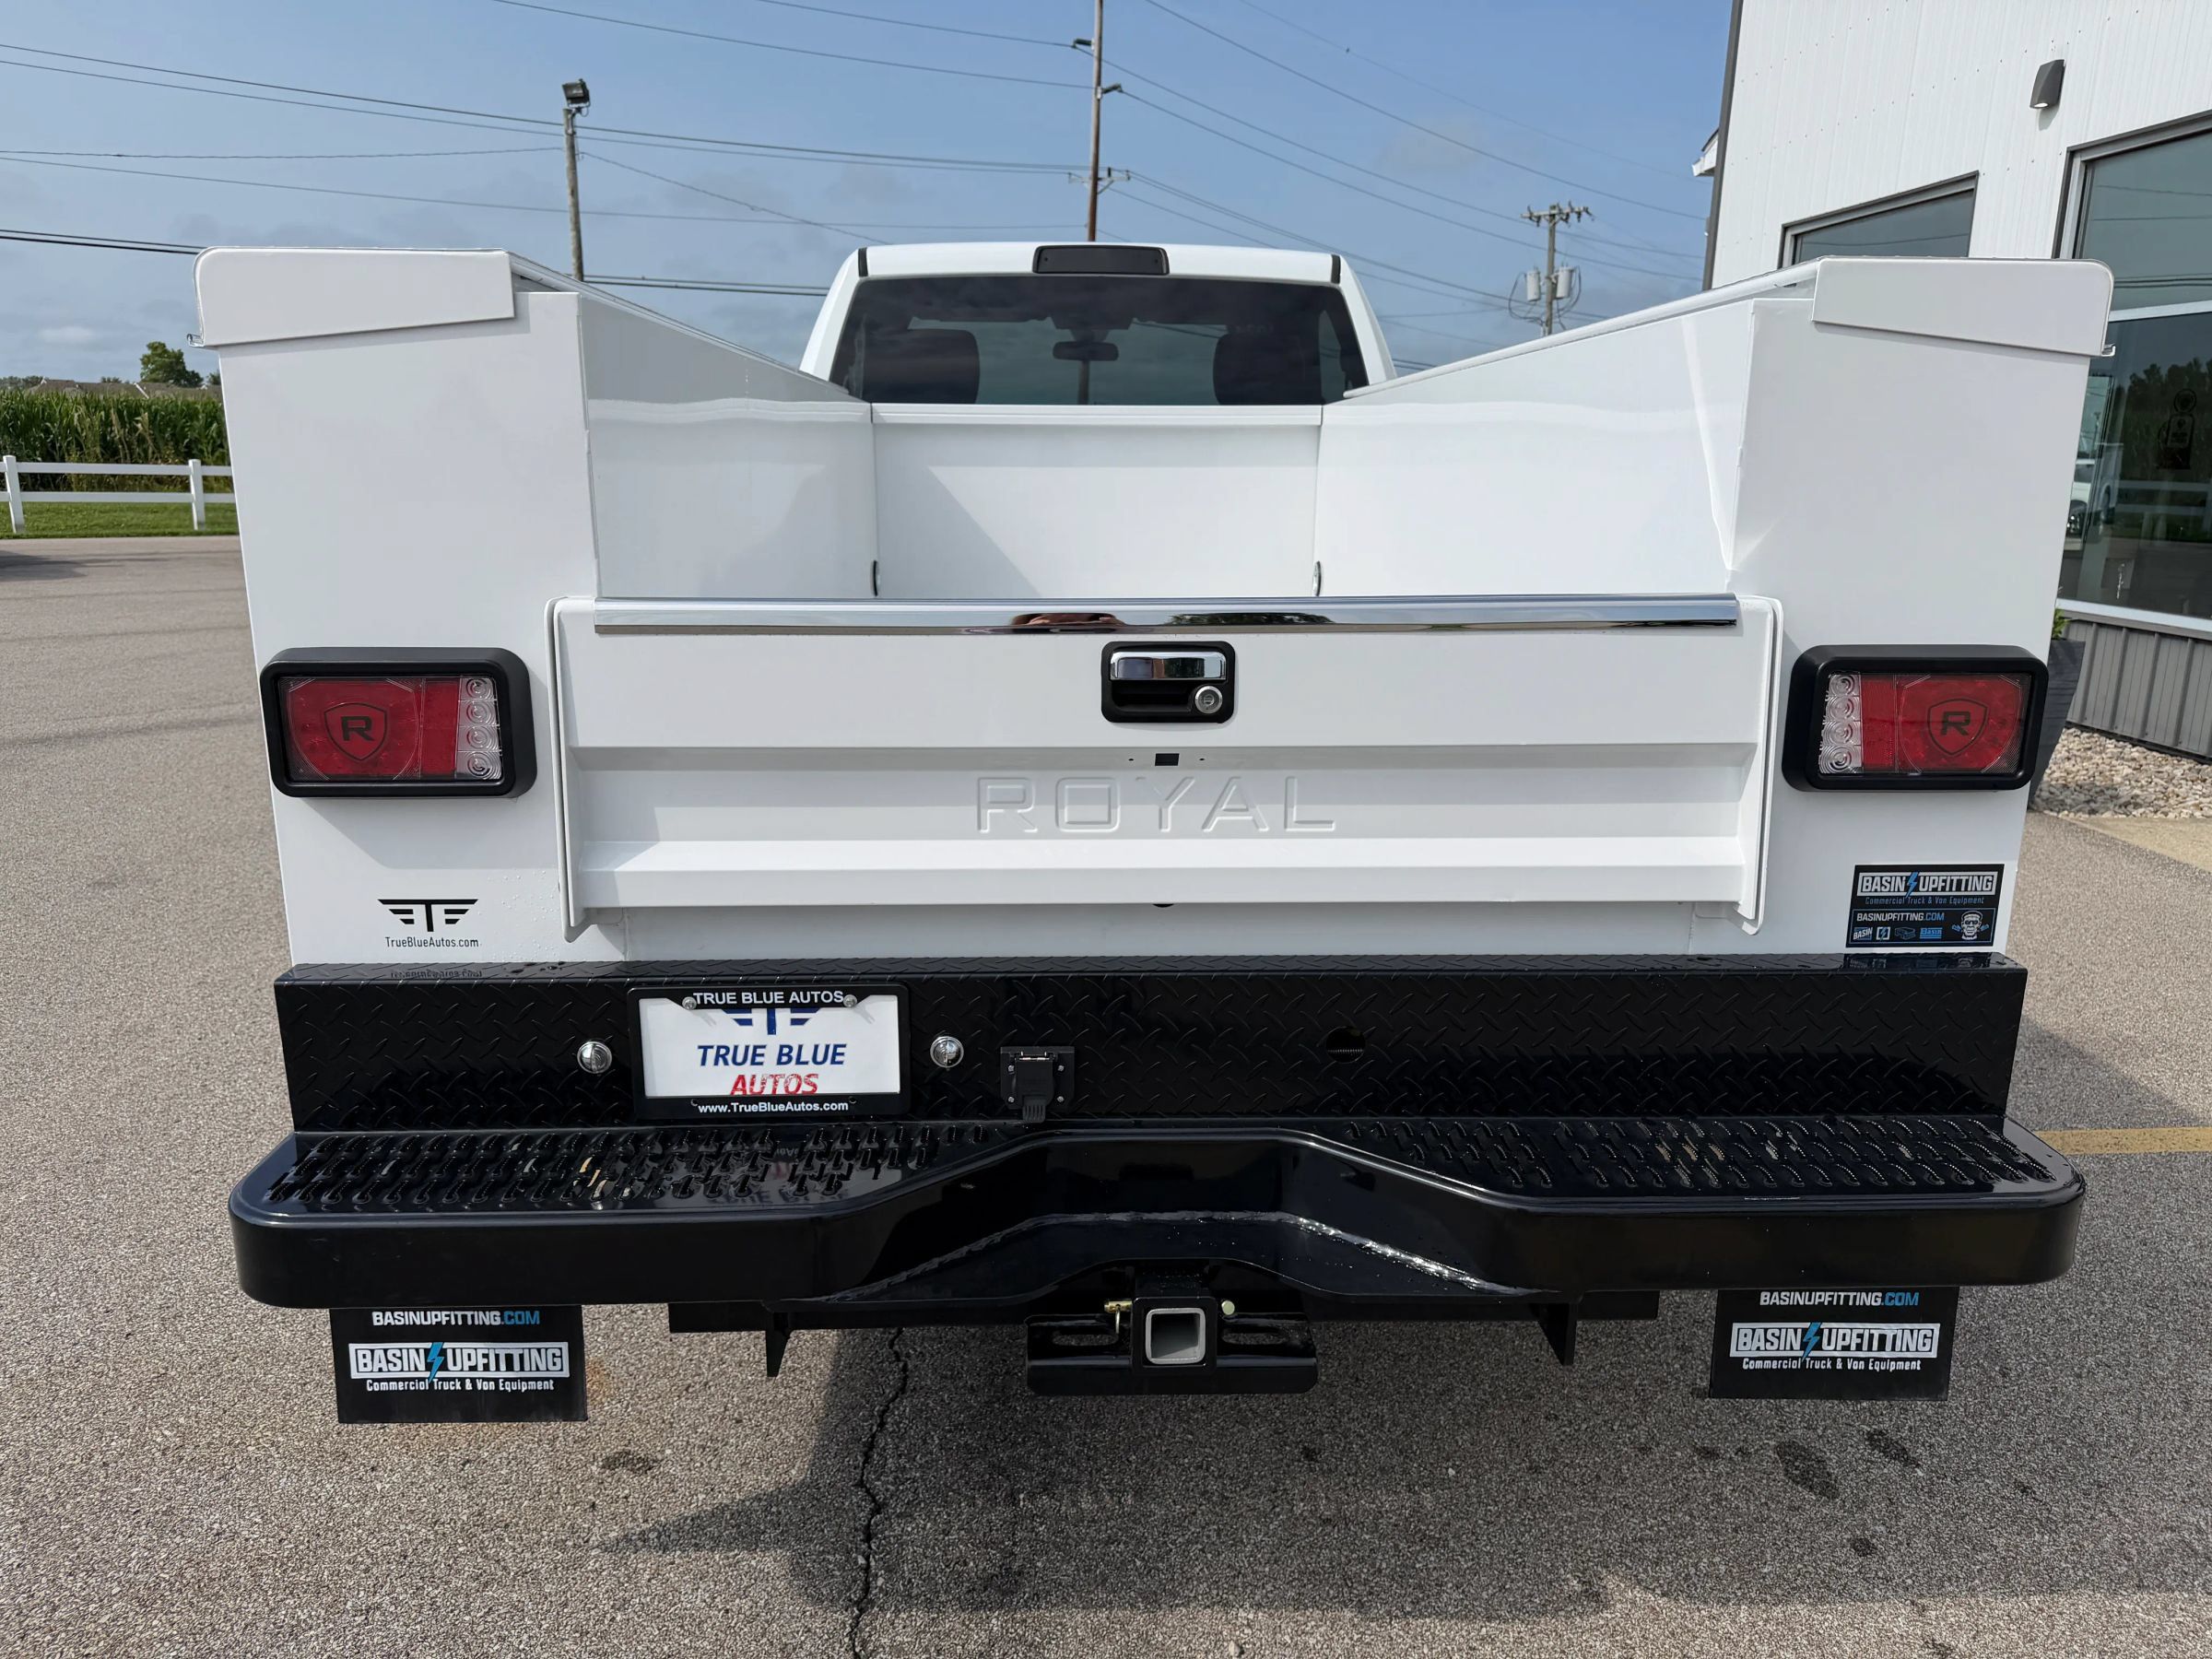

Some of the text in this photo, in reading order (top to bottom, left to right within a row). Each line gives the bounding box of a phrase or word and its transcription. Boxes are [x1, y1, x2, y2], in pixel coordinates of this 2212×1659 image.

[340, 715, 375, 742] R
[1940, 711, 1971, 735] R
[977, 776, 1335, 833] ROYAL
[1862, 875, 1993, 892] BASIN UPFITTING
[1865, 896, 1905, 905] Commercial
[1907, 896, 1925, 905] Truck
[1935, 896, 1947, 904] Van
[1949, 896, 1984, 905] Equipment
[1856, 912, 1945, 922] BASINUPFITTING.COM
[385, 936, 479, 947] TrueBlueAutos.com
[693, 991, 843, 1005] TRUE BLUE AUTOS
[697, 1043, 847, 1066] TRUE BLUE
[730, 1073, 819, 1096] AUTOS
[698, 1101, 849, 1114] www.TrueBlueAutos.com
[1759, 1291, 1919, 1306] BASINUPFITTING.COM
[371, 1311, 540, 1326] BASINUPFITTING.COM
[1737, 1328, 1933, 1352] BASIN UPFITTING
[357, 1347, 562, 1372] BASIN UPFITTING
[1742, 1358, 1922, 1371] Commercial Truck & Van Equipment
[366, 1379, 555, 1392] Commercial Truck & Van Equipment
